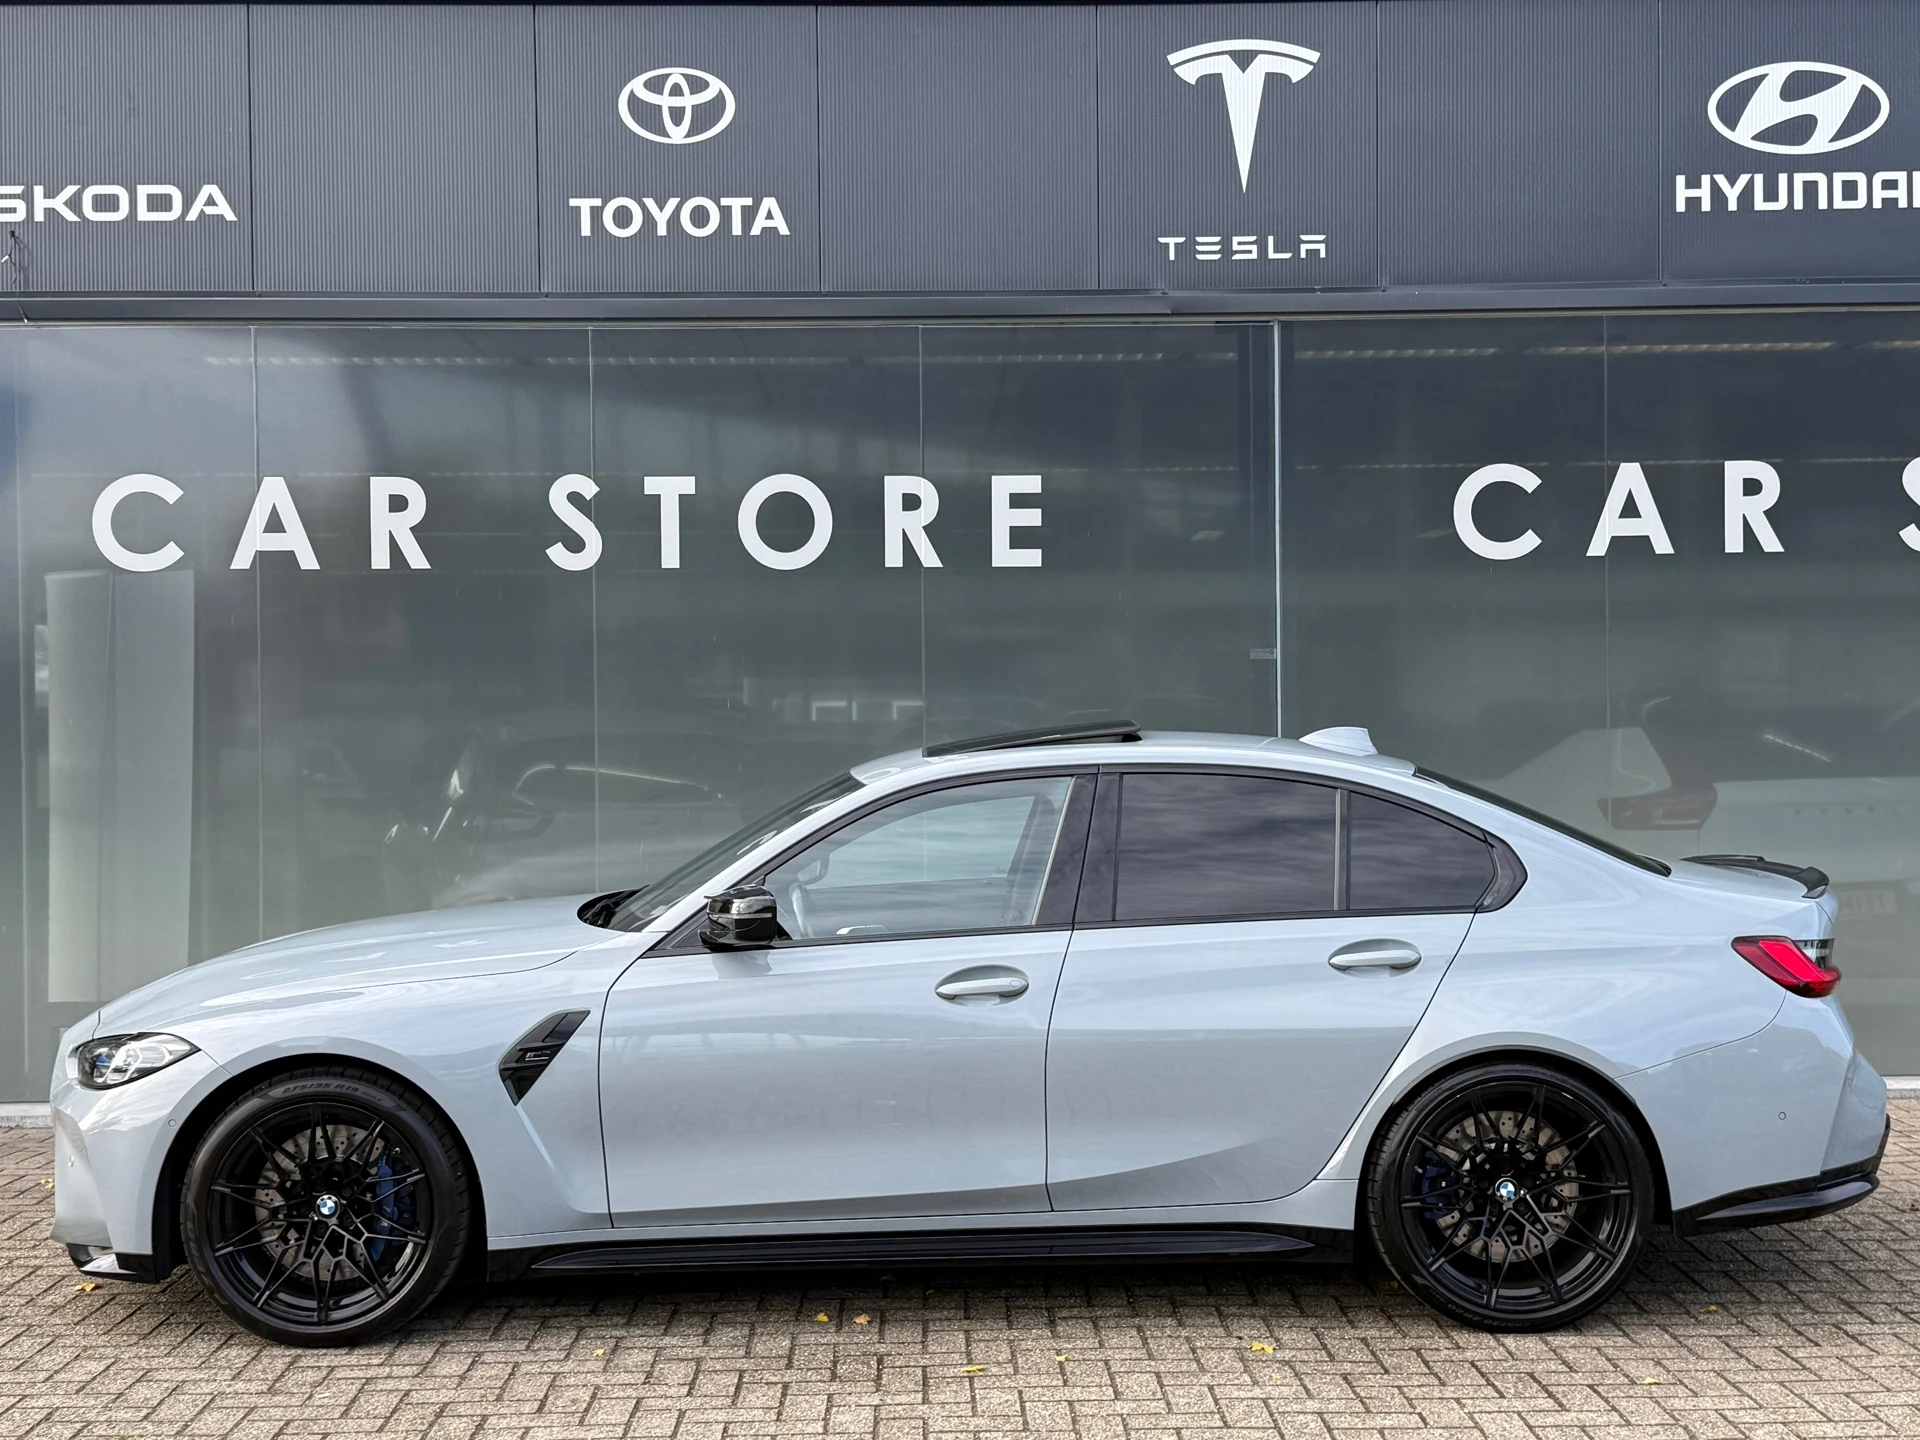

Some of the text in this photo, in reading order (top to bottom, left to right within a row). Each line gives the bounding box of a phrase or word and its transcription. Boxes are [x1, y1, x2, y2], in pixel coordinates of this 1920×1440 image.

[0, 184, 238, 223] SKODA
[569, 196, 791, 238] TOYOTA
[1157, 234, 1328, 261] TESLA
[91, 473, 1042, 573] CAR STORE
[1453, 461, 1785, 560] CAR
